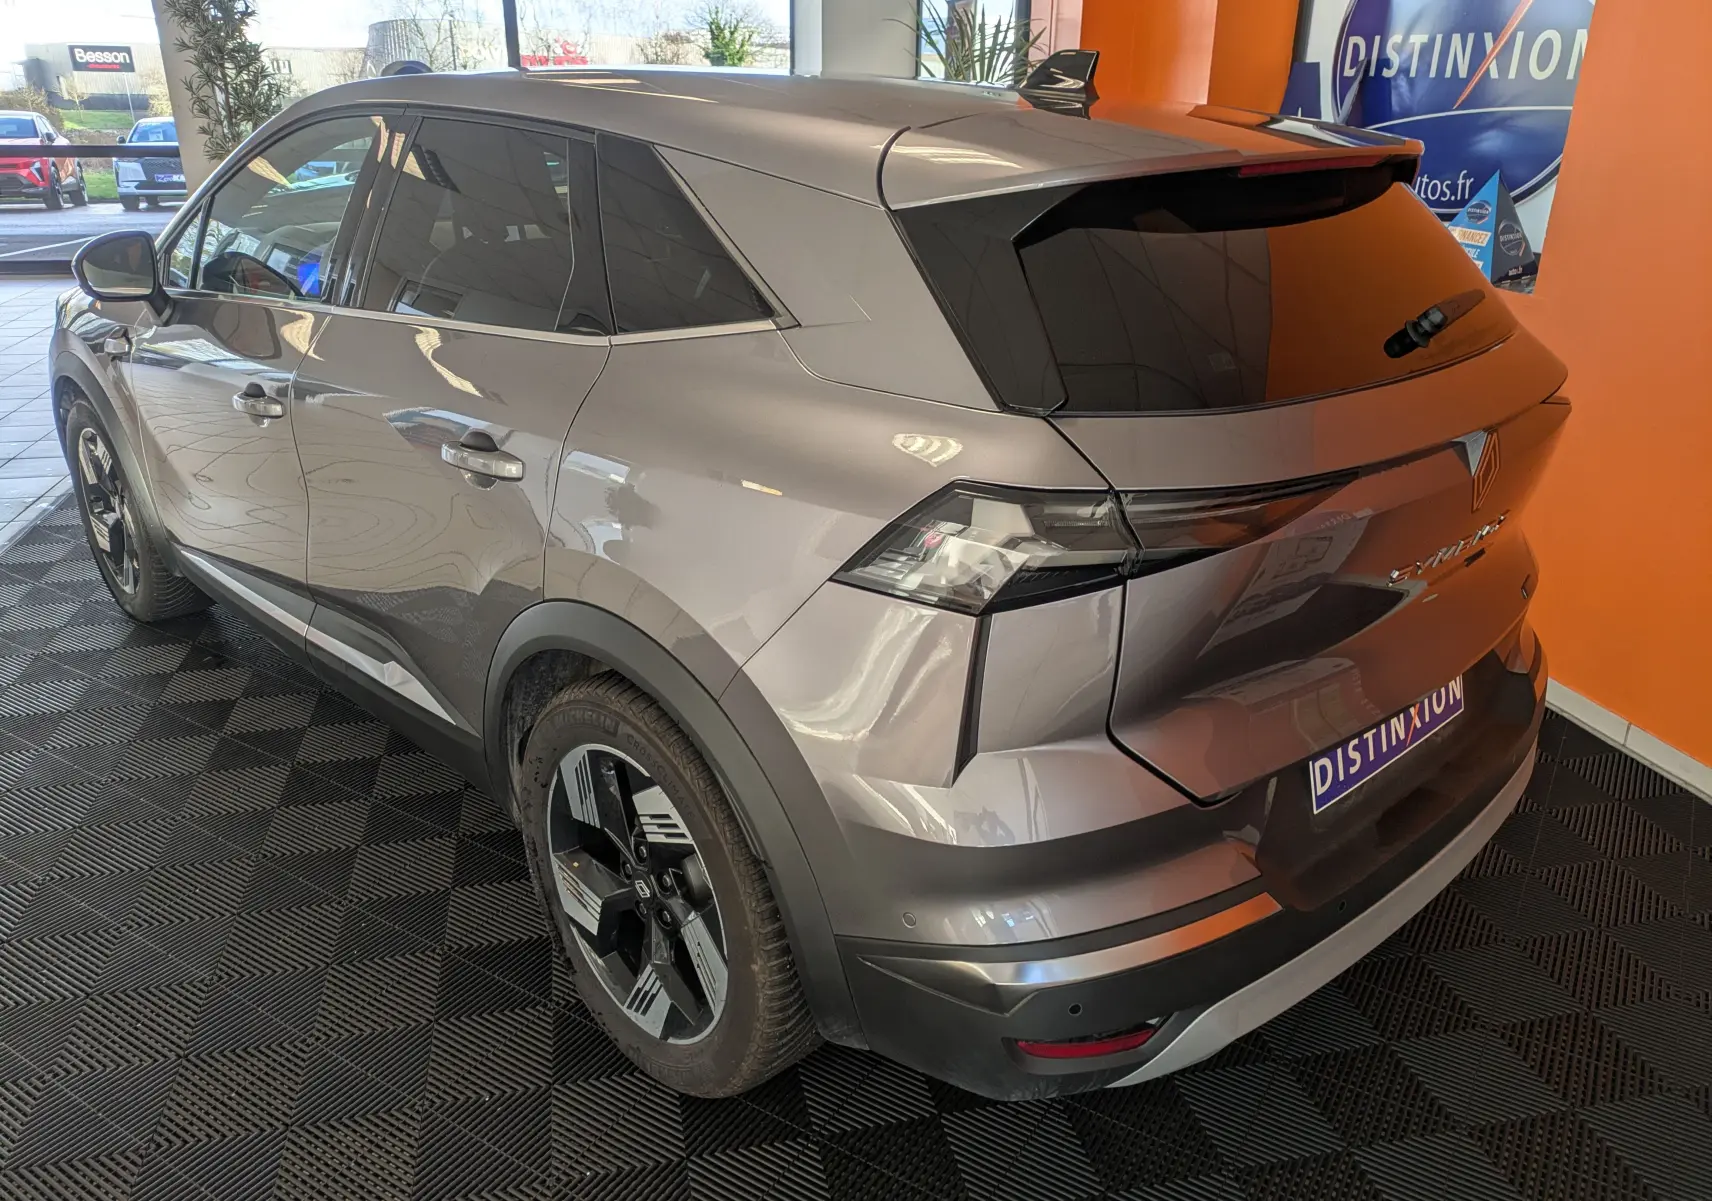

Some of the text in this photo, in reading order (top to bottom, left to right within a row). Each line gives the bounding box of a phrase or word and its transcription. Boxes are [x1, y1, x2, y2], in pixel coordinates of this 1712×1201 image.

[74, 48, 131, 63] Besson
[1343, 29, 1588, 80] DISTINXION
[1415, 170, 1474, 201] tos.fr
[1314, 676, 1461, 797] DISTINXION
